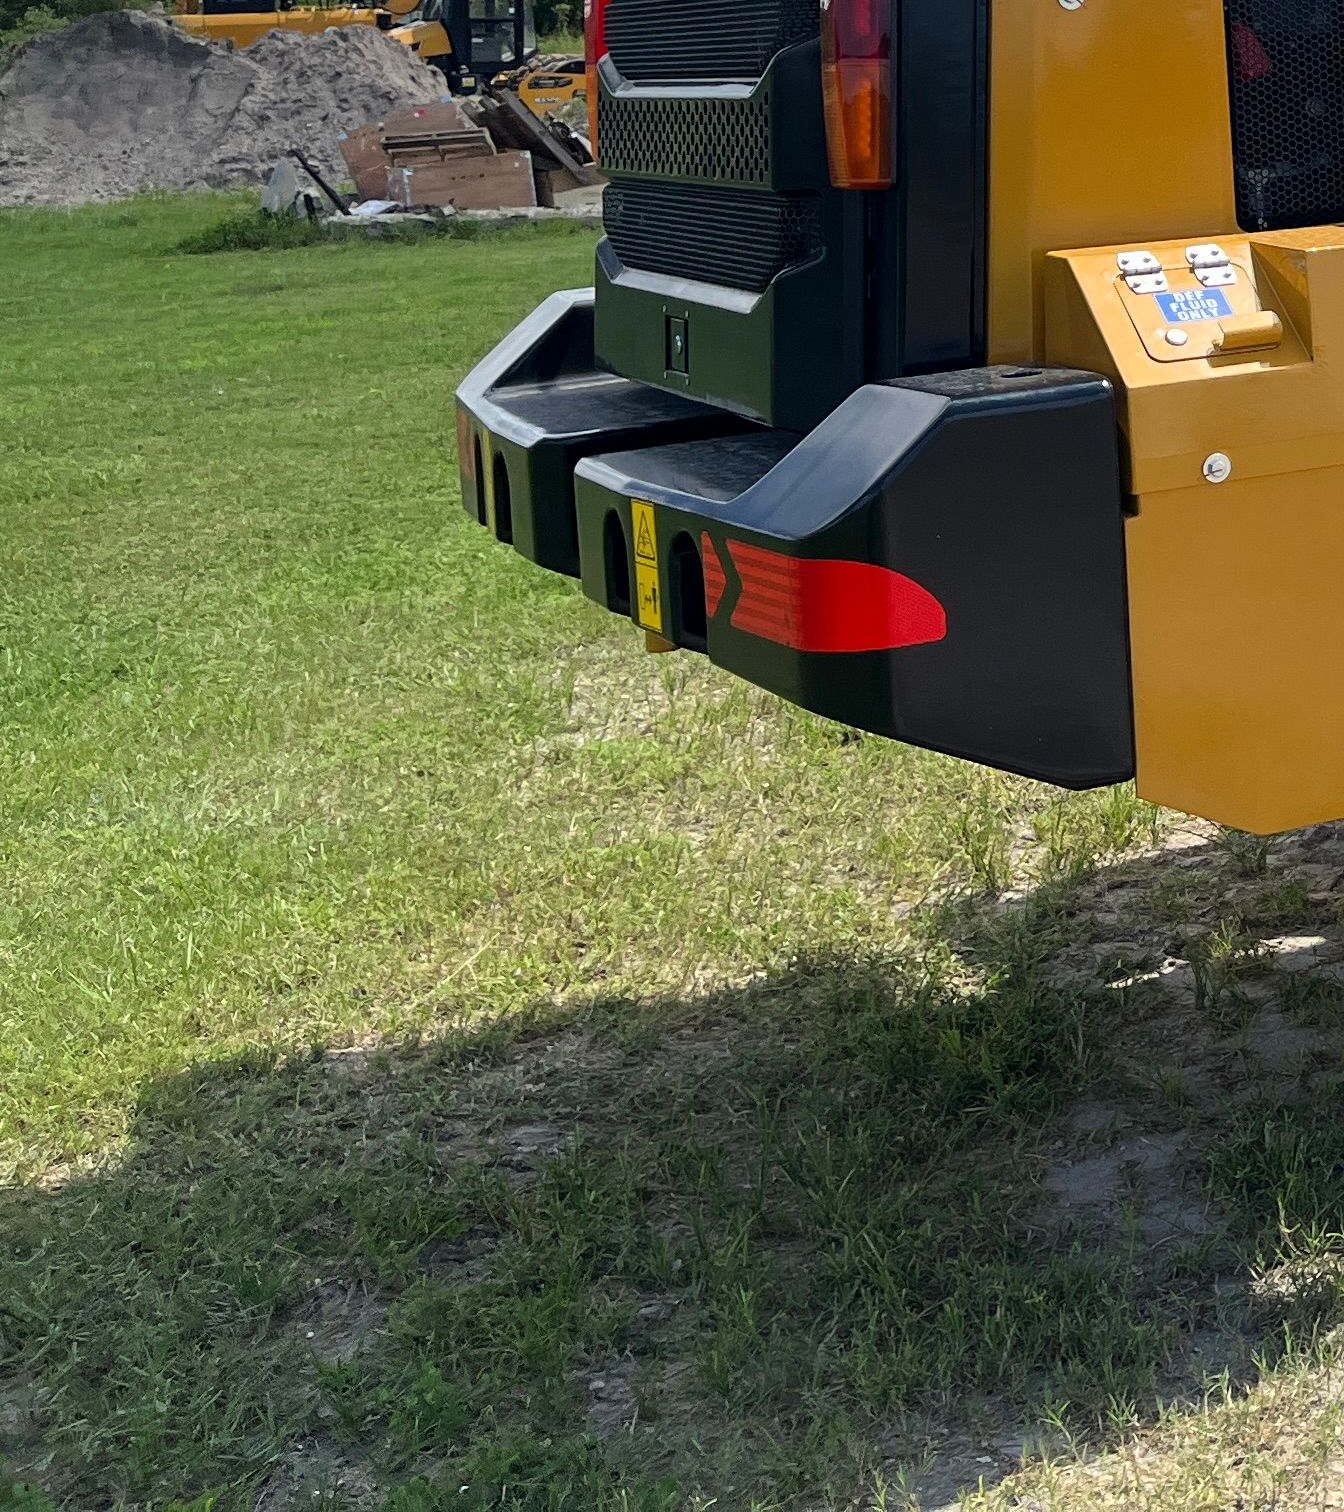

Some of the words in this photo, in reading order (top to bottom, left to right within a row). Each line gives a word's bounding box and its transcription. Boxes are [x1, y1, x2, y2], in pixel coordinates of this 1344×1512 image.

[1172, 290, 1205, 302] DEF
[1169, 298, 1219, 313] FLUID
[1176, 307, 1219, 321] ONLY
